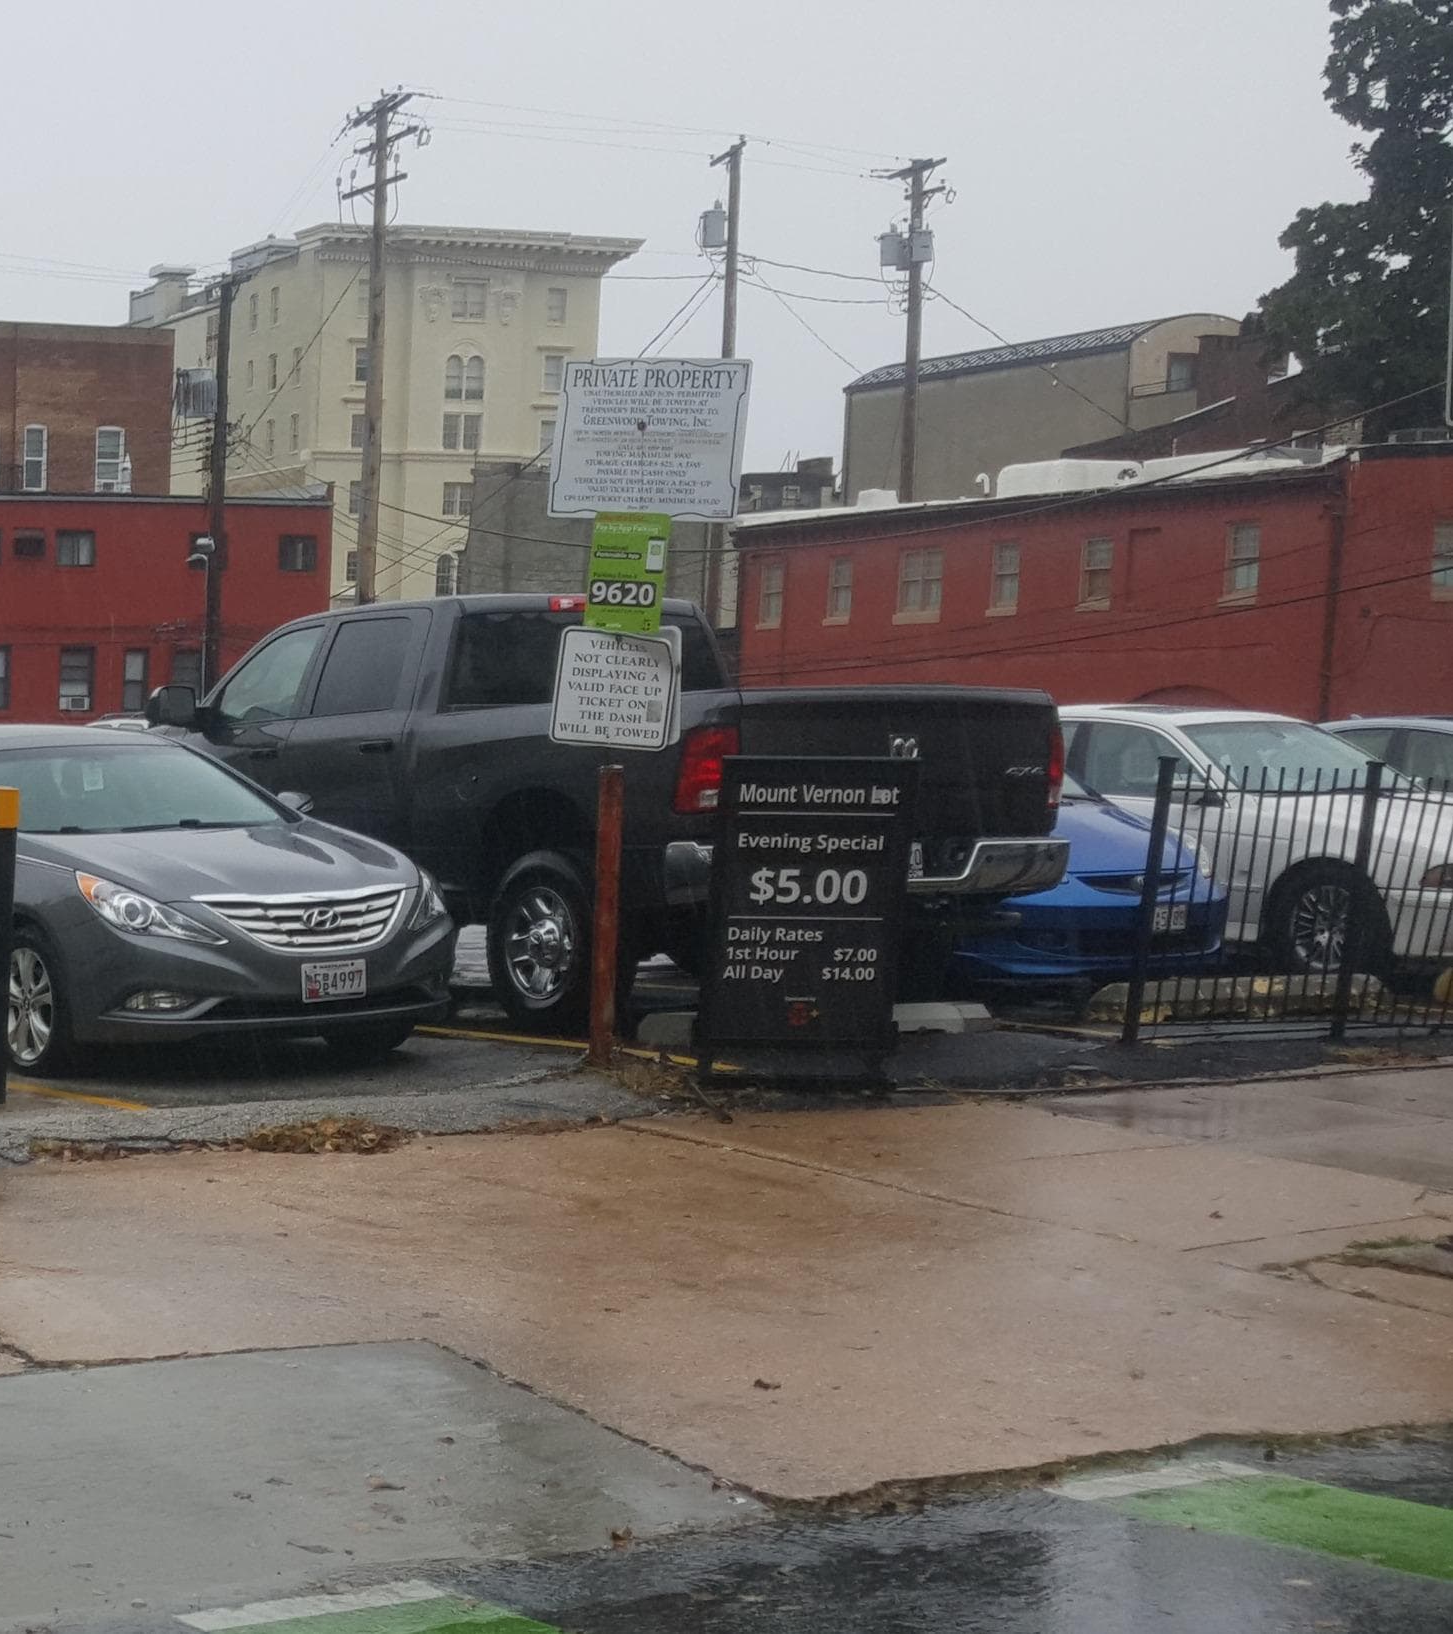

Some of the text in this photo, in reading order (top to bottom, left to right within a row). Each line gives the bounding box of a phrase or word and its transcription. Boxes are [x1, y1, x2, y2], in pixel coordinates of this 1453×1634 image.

[573, 369, 738, 389] PRIVATE PROPERTY
[629, 398, 650, 406] WILL
[583, 414, 643, 426] GREENWOOD
[642, 469, 664, 477] CASH
[591, 581, 654, 606] 9620
[574, 653, 660, 668] NOT CLEARLY
[572, 667, 660, 682] DISPLAYING A
[568, 681, 662, 697] VALID FACE UP
[578, 695, 647, 710] TICKET ON
[579, 710, 642, 724] THE DASH
[559, 723, 660, 739] WILL BE TOWED
[739, 783, 900, 805] Mount Vernon Lot
[738, 832, 885, 854] Evening Special
[749, 867, 868, 906] $5.00
[727, 926, 824, 945] Daily Rates
[726, 947, 877, 962] 1st Hour $7.00
[722, 965, 875, 984] All Day $14.00
